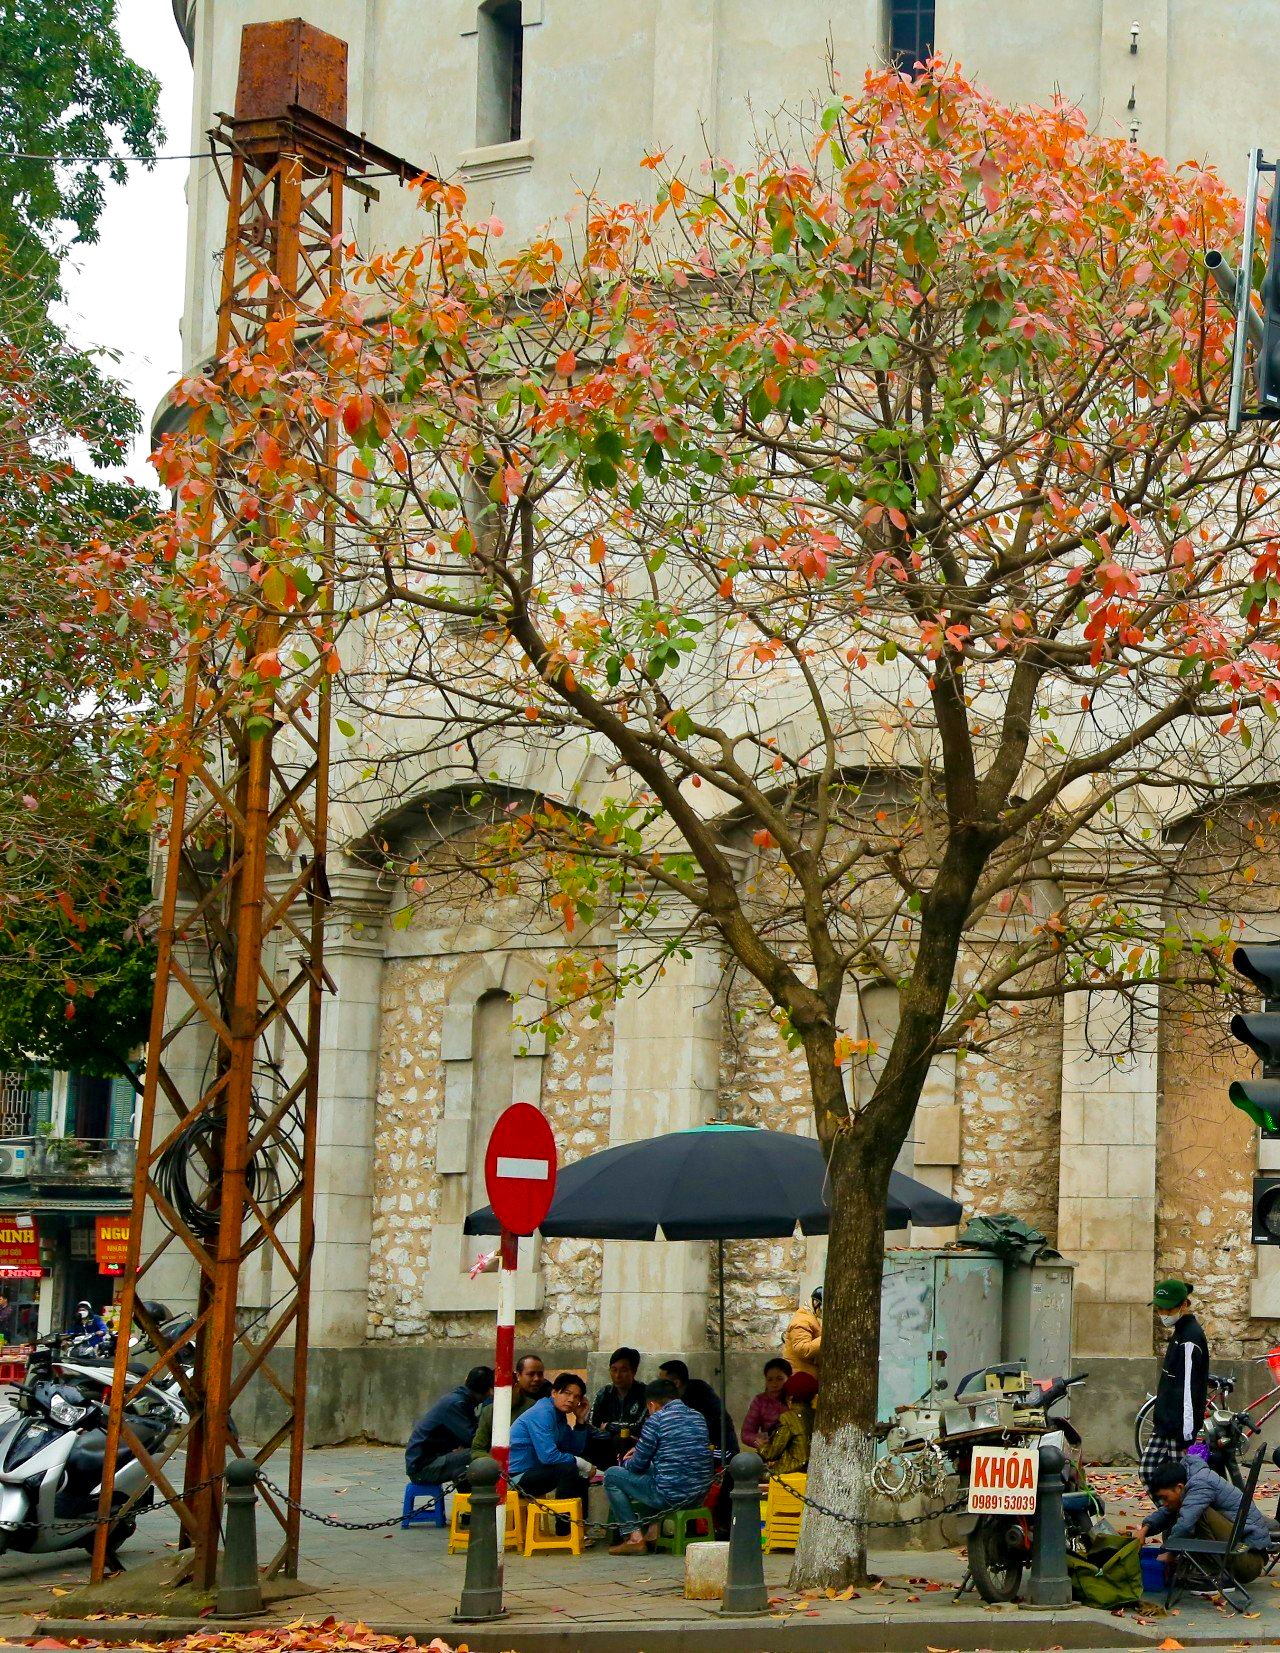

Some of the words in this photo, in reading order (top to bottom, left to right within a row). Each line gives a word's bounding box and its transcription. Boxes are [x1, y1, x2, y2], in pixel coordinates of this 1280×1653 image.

[101, 1227, 130, 1240] NGU
[974, 1452, 1034, 1489] KHÓA
[972, 1494, 1035, 1510] 0989153039
